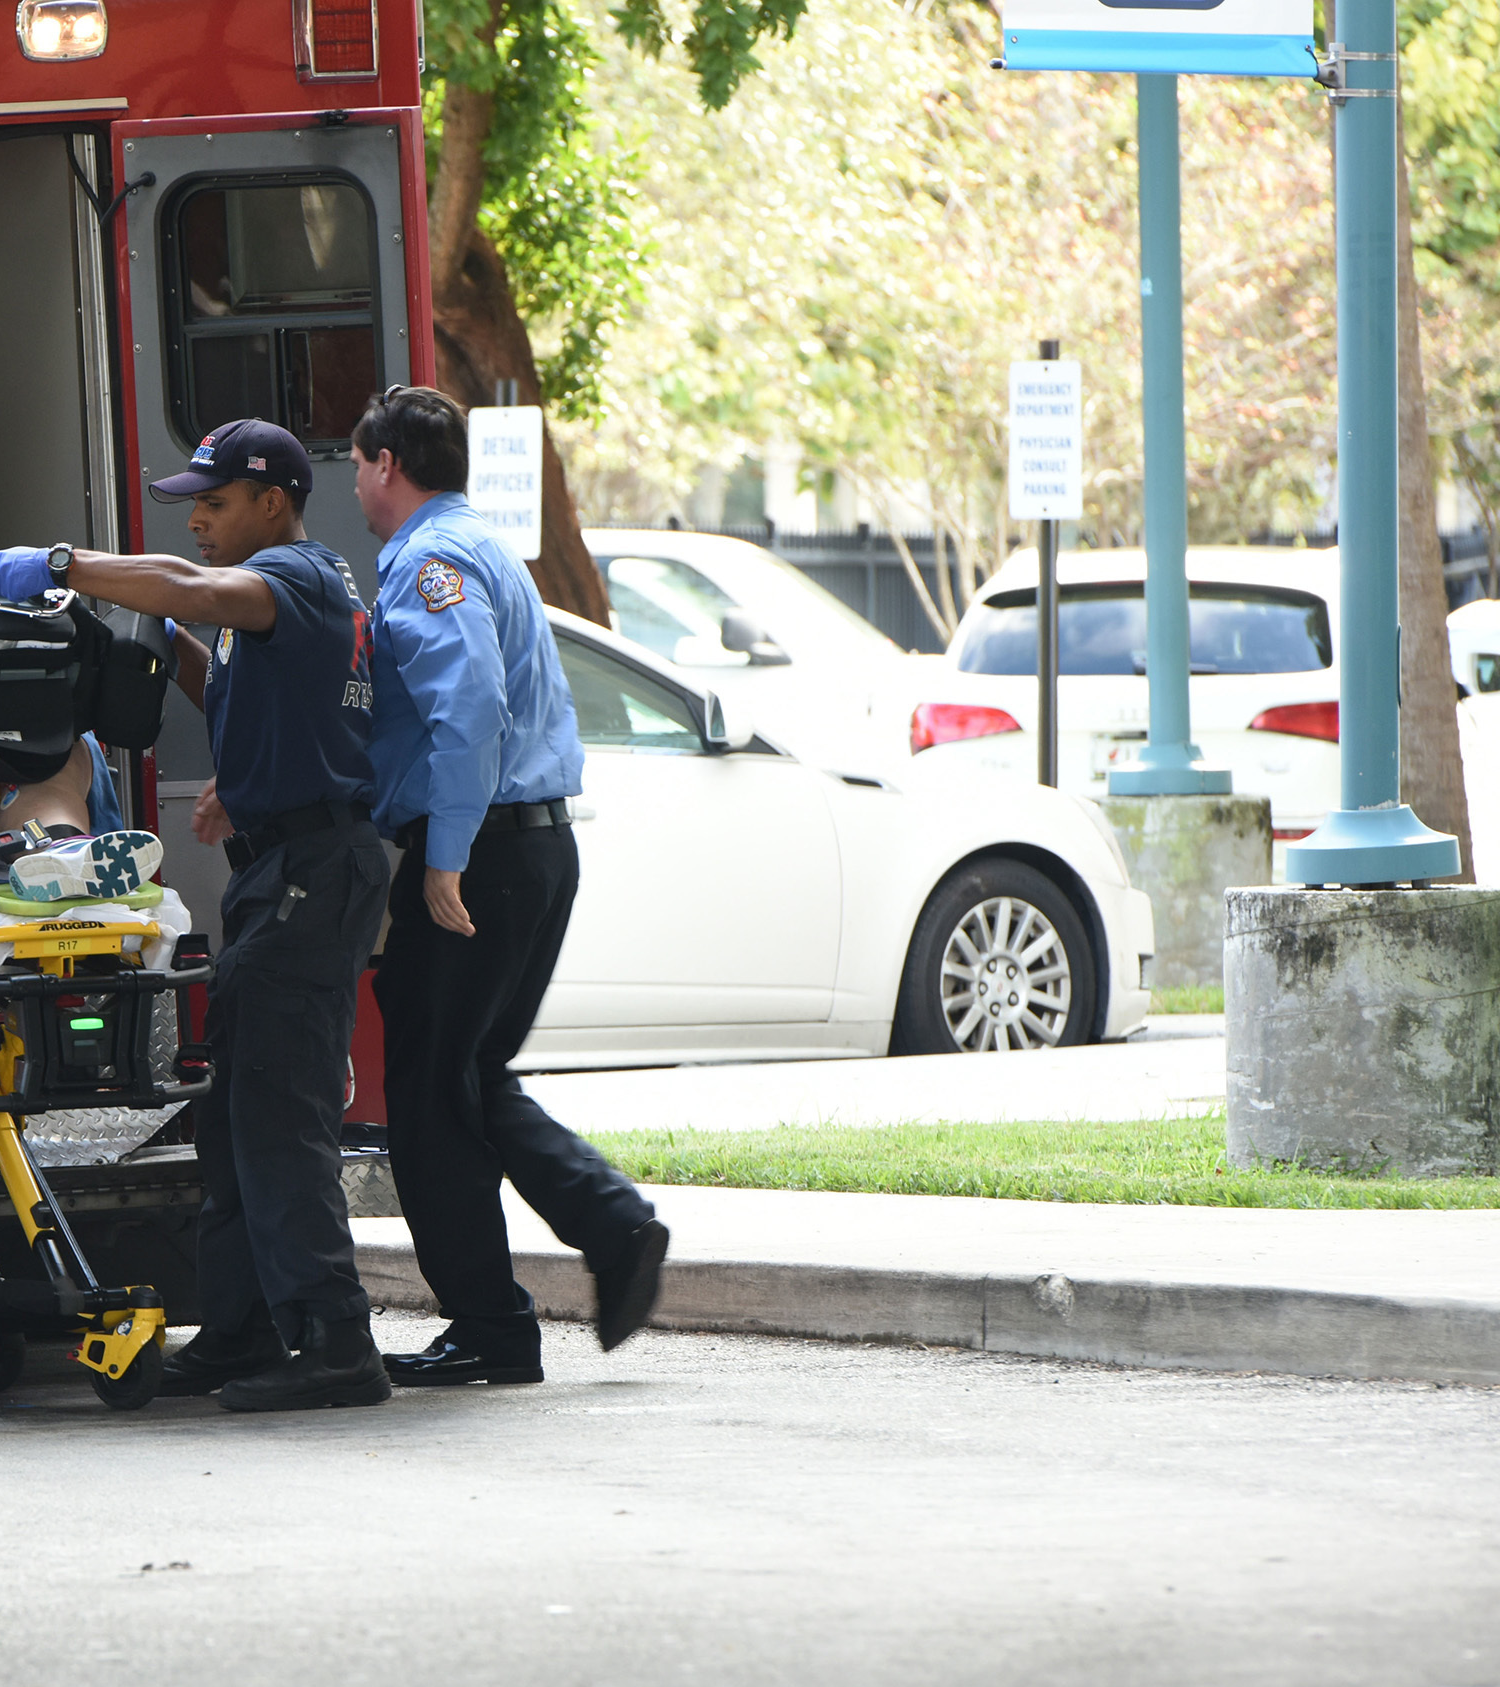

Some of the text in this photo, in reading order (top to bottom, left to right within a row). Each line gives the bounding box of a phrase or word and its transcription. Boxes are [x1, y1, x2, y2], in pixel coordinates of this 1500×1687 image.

[1017, 382, 1072, 396] EMERGENCY
[1016, 403, 1074, 417] DEPARTMENT
[483, 437, 527, 455] DETAIL
[1018, 436, 1072, 448] PHYSICIAN
[477, 472, 533, 491] OFFICER
[1023, 482, 1067, 495] PARKING
[481, 510, 533, 528] ARKING
[46, 921, 98, 931] RUGGED
[58, 941, 78, 951] R17
